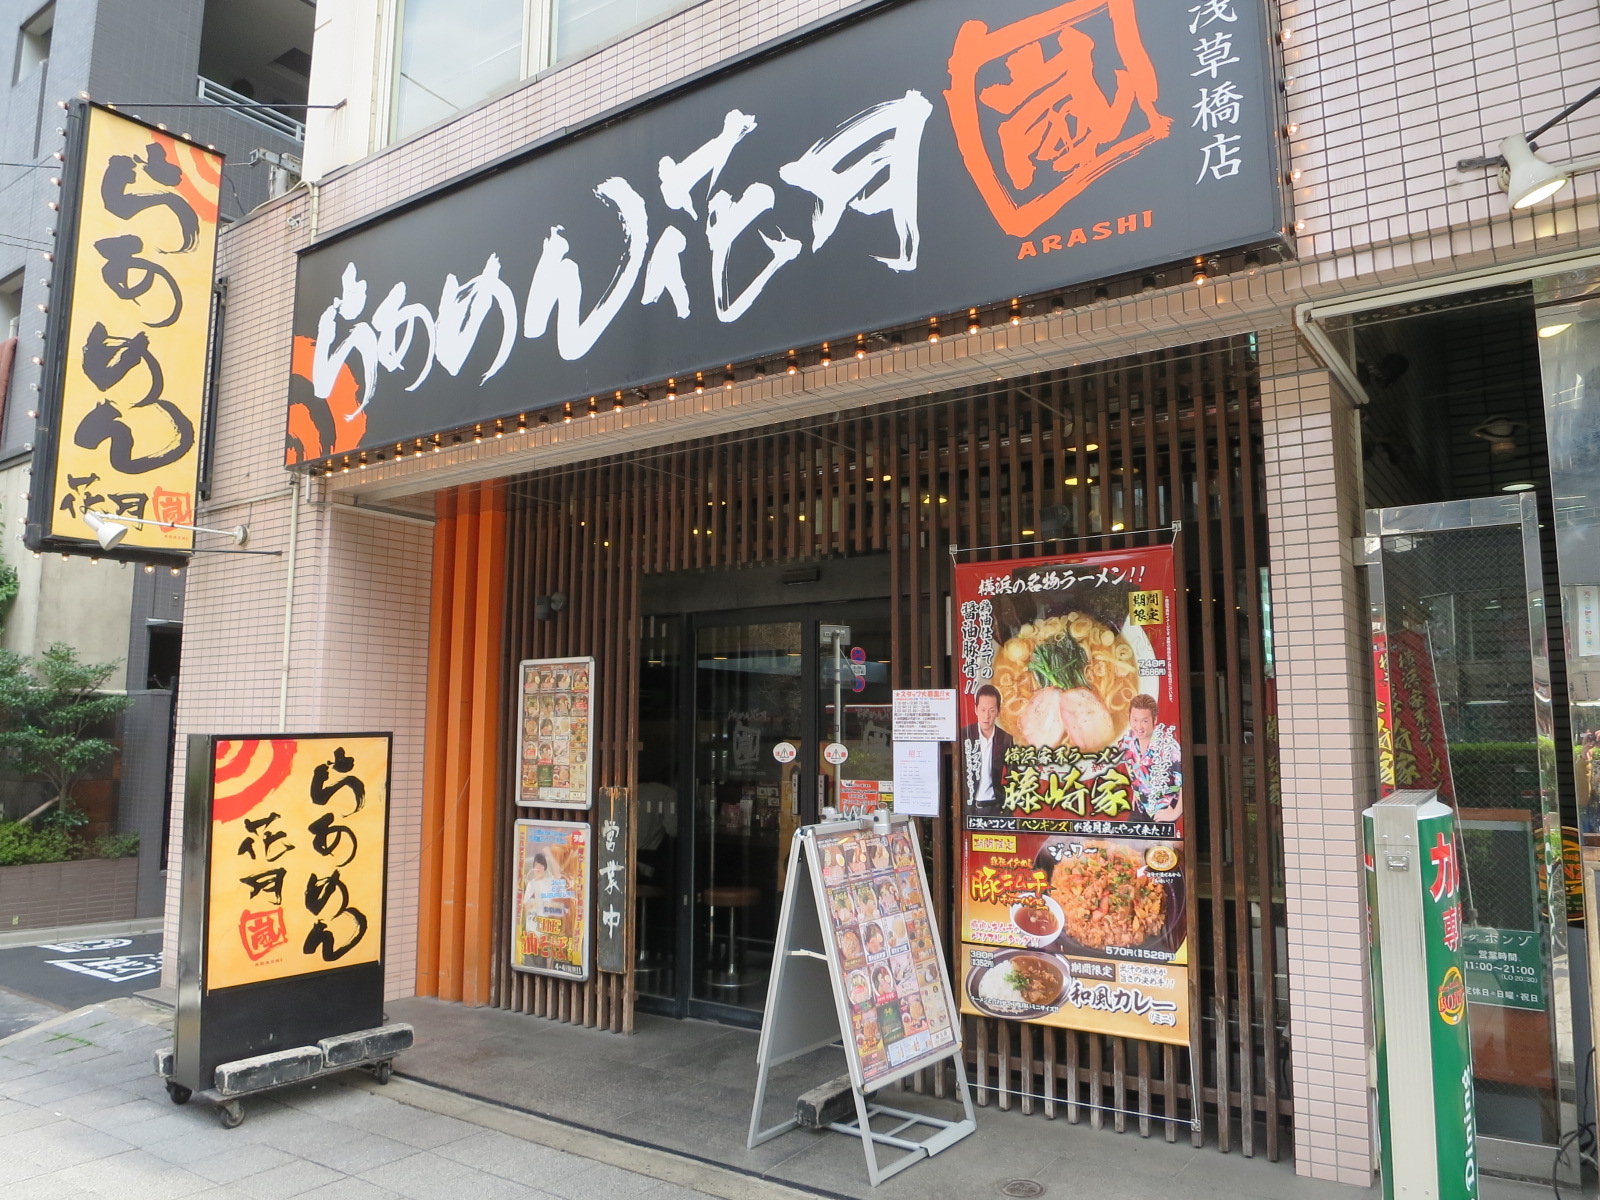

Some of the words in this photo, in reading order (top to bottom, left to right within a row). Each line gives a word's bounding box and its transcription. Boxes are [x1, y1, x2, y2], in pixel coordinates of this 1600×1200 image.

[1188, 0, 1244, 185] 浅草橋店
[1017, 211, 1153, 260] ARASHI
[978, 565, 1147, 597] 横浜の名物ラーメン!!
[1004, 746, 1126, 766] 横浜家系ラーメン
[1002, 766, 1132, 817] 藤崎家
[237, 812, 296, 905] 花月
[599, 819, 625, 939] 営業中
[1071, 962, 1113, 978] 期間限定
[1478, 950, 1517, 961] 営業時間
[1069, 981, 1175, 1014] 和風カレー
